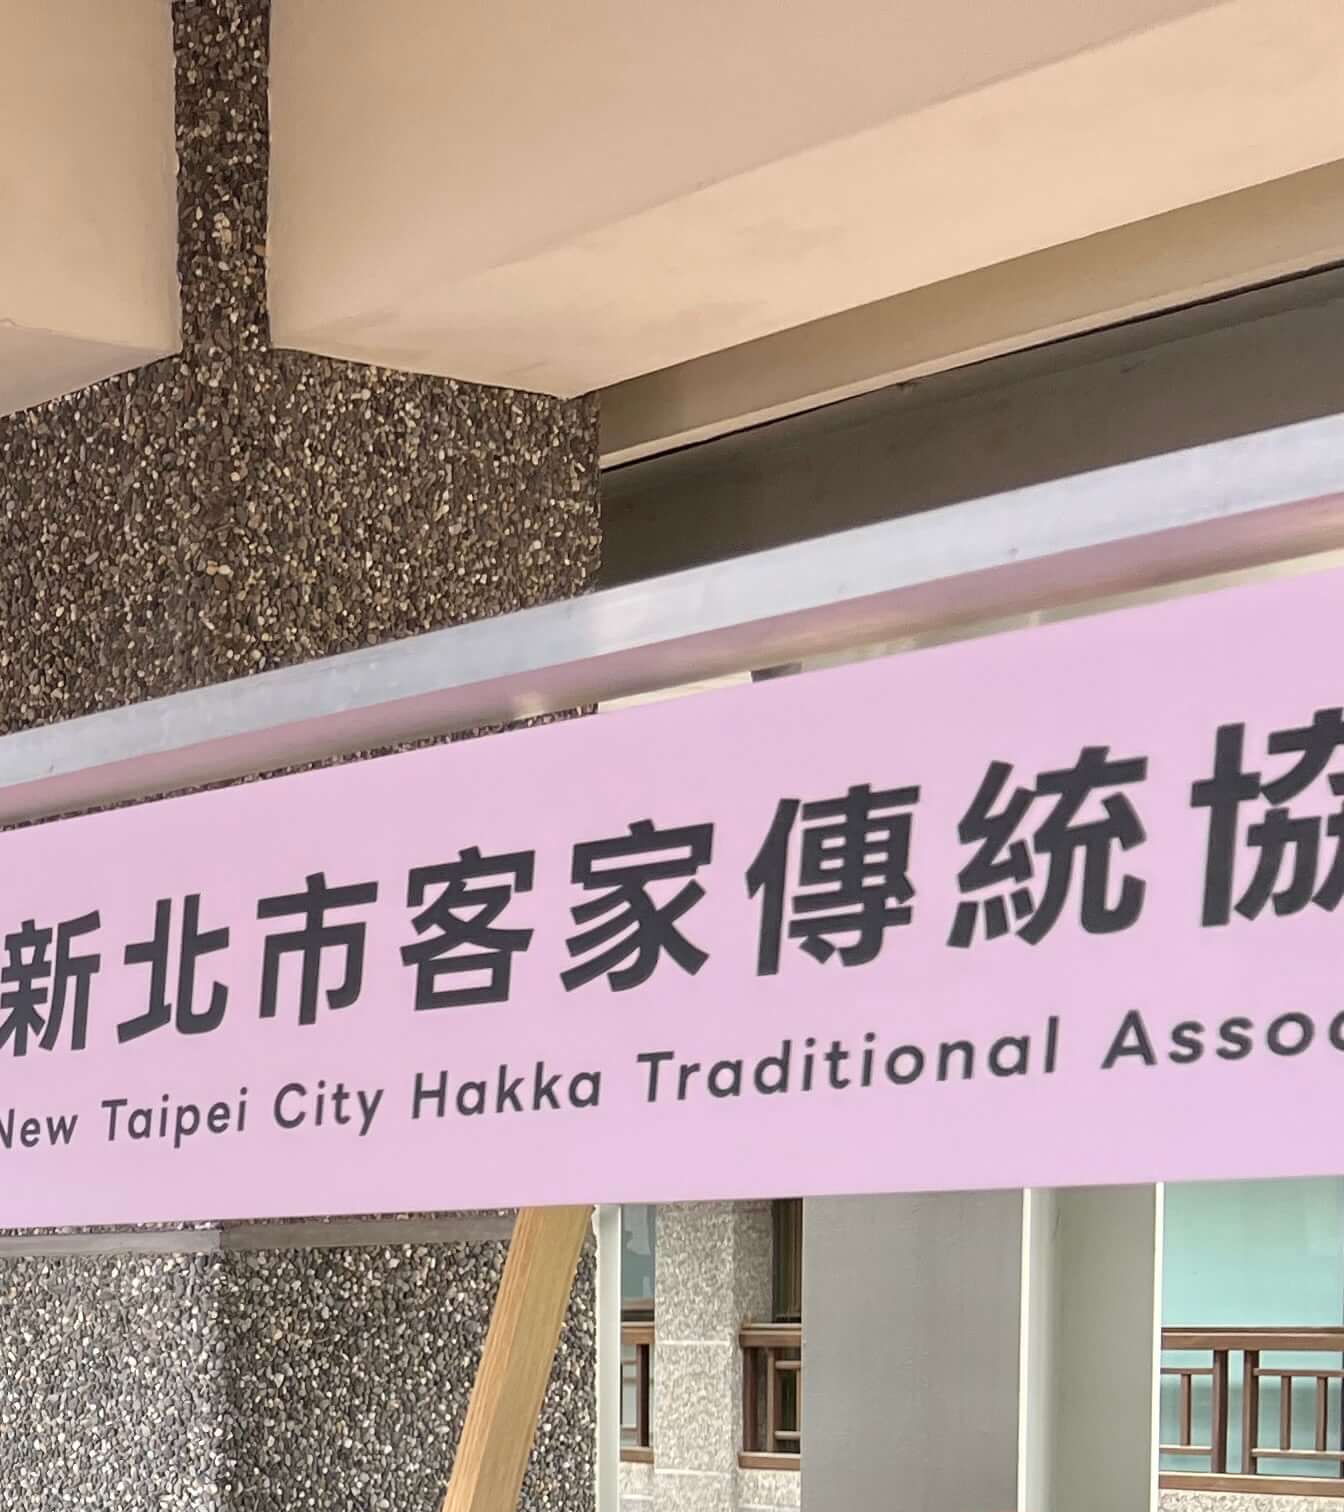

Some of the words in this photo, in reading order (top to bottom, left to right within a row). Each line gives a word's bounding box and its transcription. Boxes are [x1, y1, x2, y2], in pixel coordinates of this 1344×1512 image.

[101, 1087, 249, 1148] Taipei
[273, 1080, 384, 1136] City
[411, 1061, 602, 1119] Hakka
[636, 1016, 1060, 1102] Traditional
